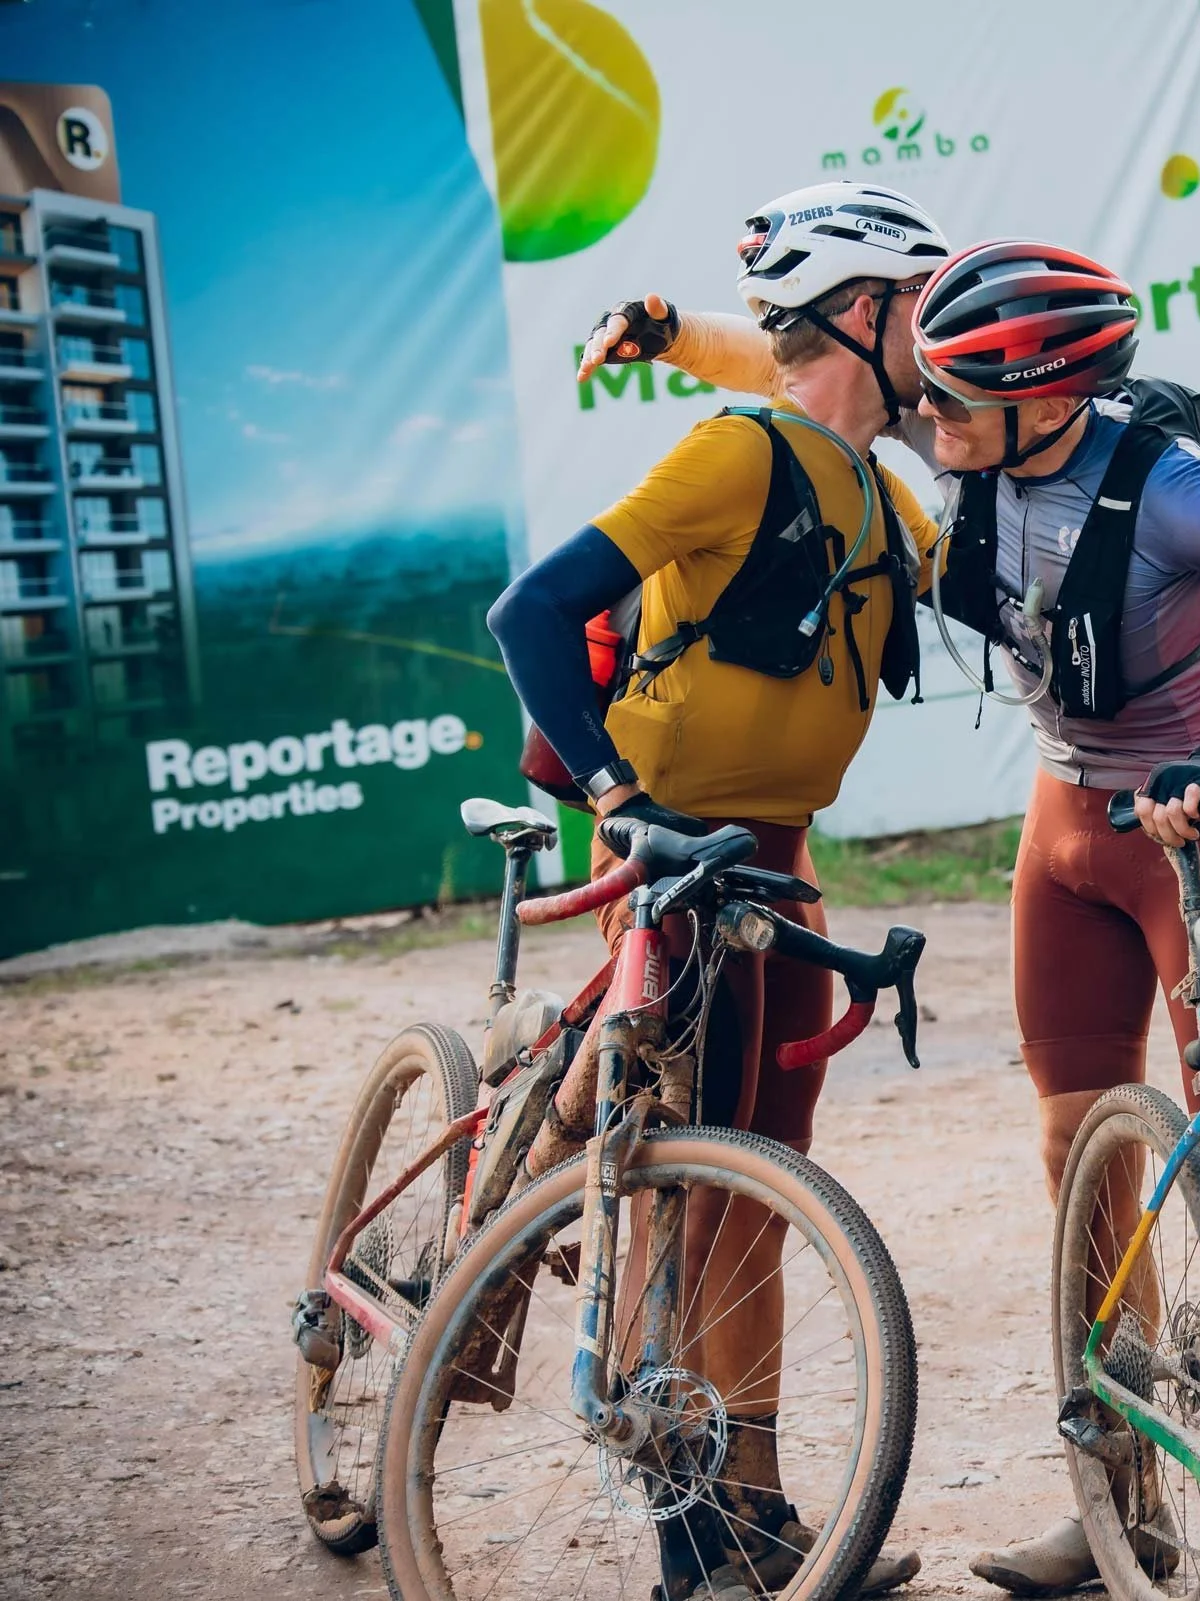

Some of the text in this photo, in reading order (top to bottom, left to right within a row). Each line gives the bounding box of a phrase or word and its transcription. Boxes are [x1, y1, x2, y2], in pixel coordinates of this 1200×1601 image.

[821, 131, 990, 170] mamba
[788, 204, 834, 227] 226ERS
[862, 221, 901, 240] ABUS
[1022, 357, 1067, 379] GIRO
[1080, 644, 1092, 706] outdoor INOXTO
[151, 780, 364, 835] Properties
[641, 939, 661, 1001] BMC
